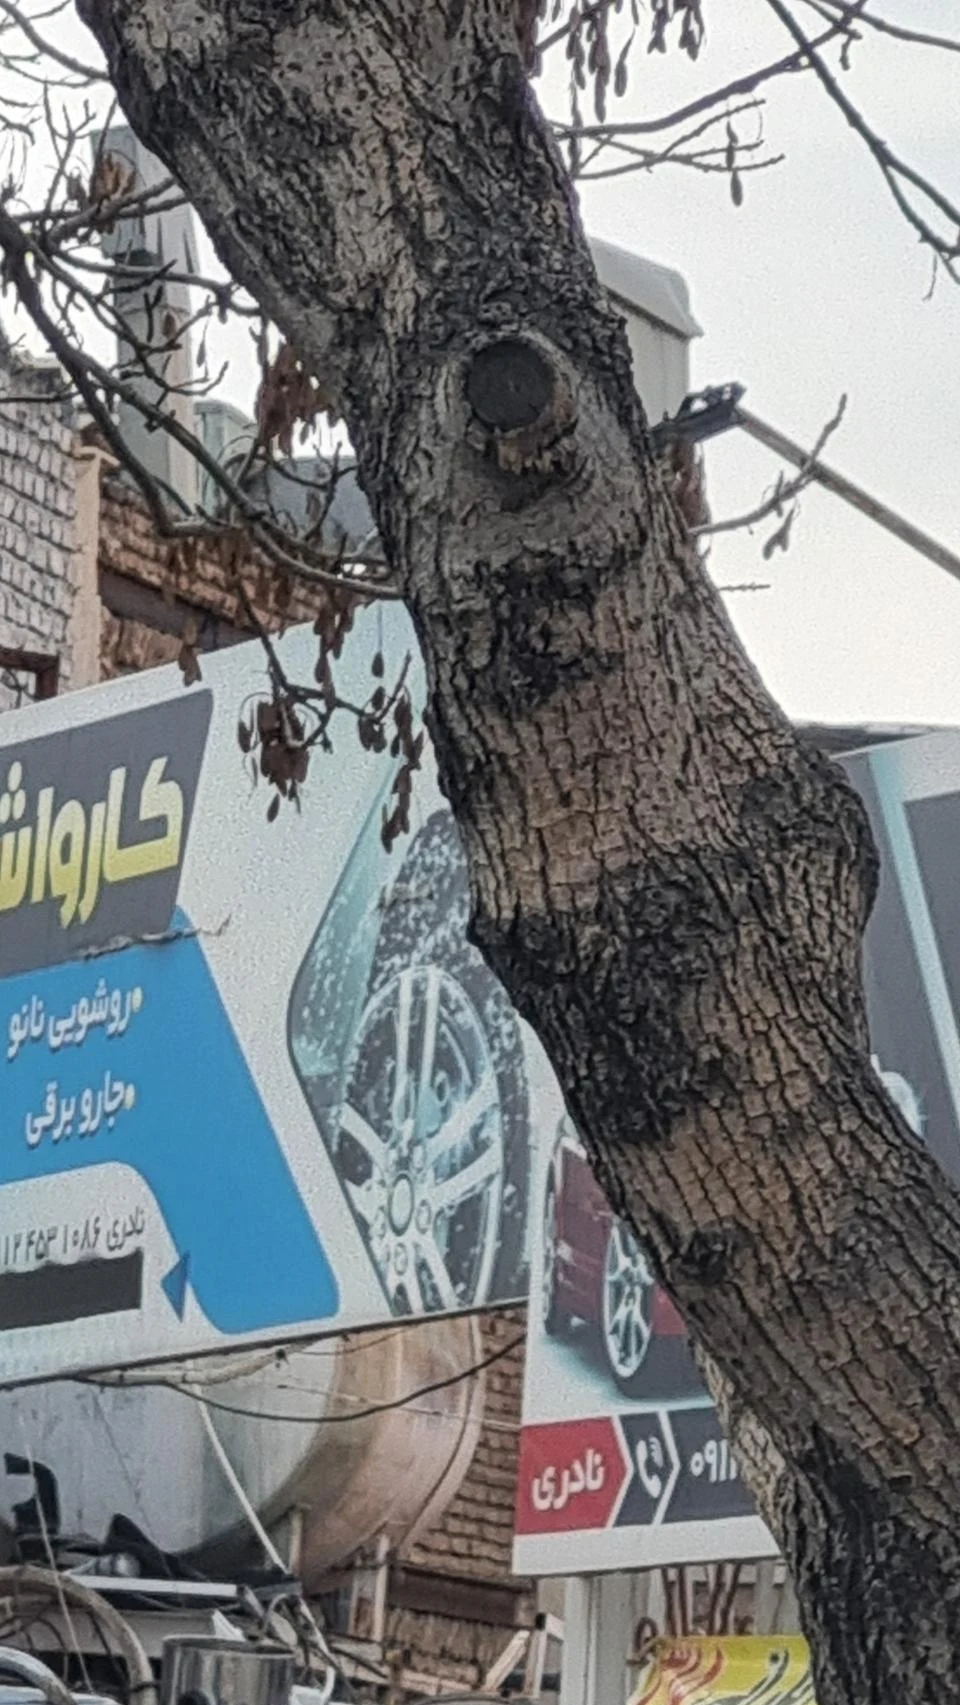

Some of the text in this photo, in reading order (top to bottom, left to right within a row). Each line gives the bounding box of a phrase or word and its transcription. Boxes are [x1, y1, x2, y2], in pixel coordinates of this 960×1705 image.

[7, 978, 131, 1060] روشویی نانو
[26, 1070, 126, 1150] جارو برقی
[106, 1205, 145, 1251] نادری
[532, 1448, 604, 1510] نادری
